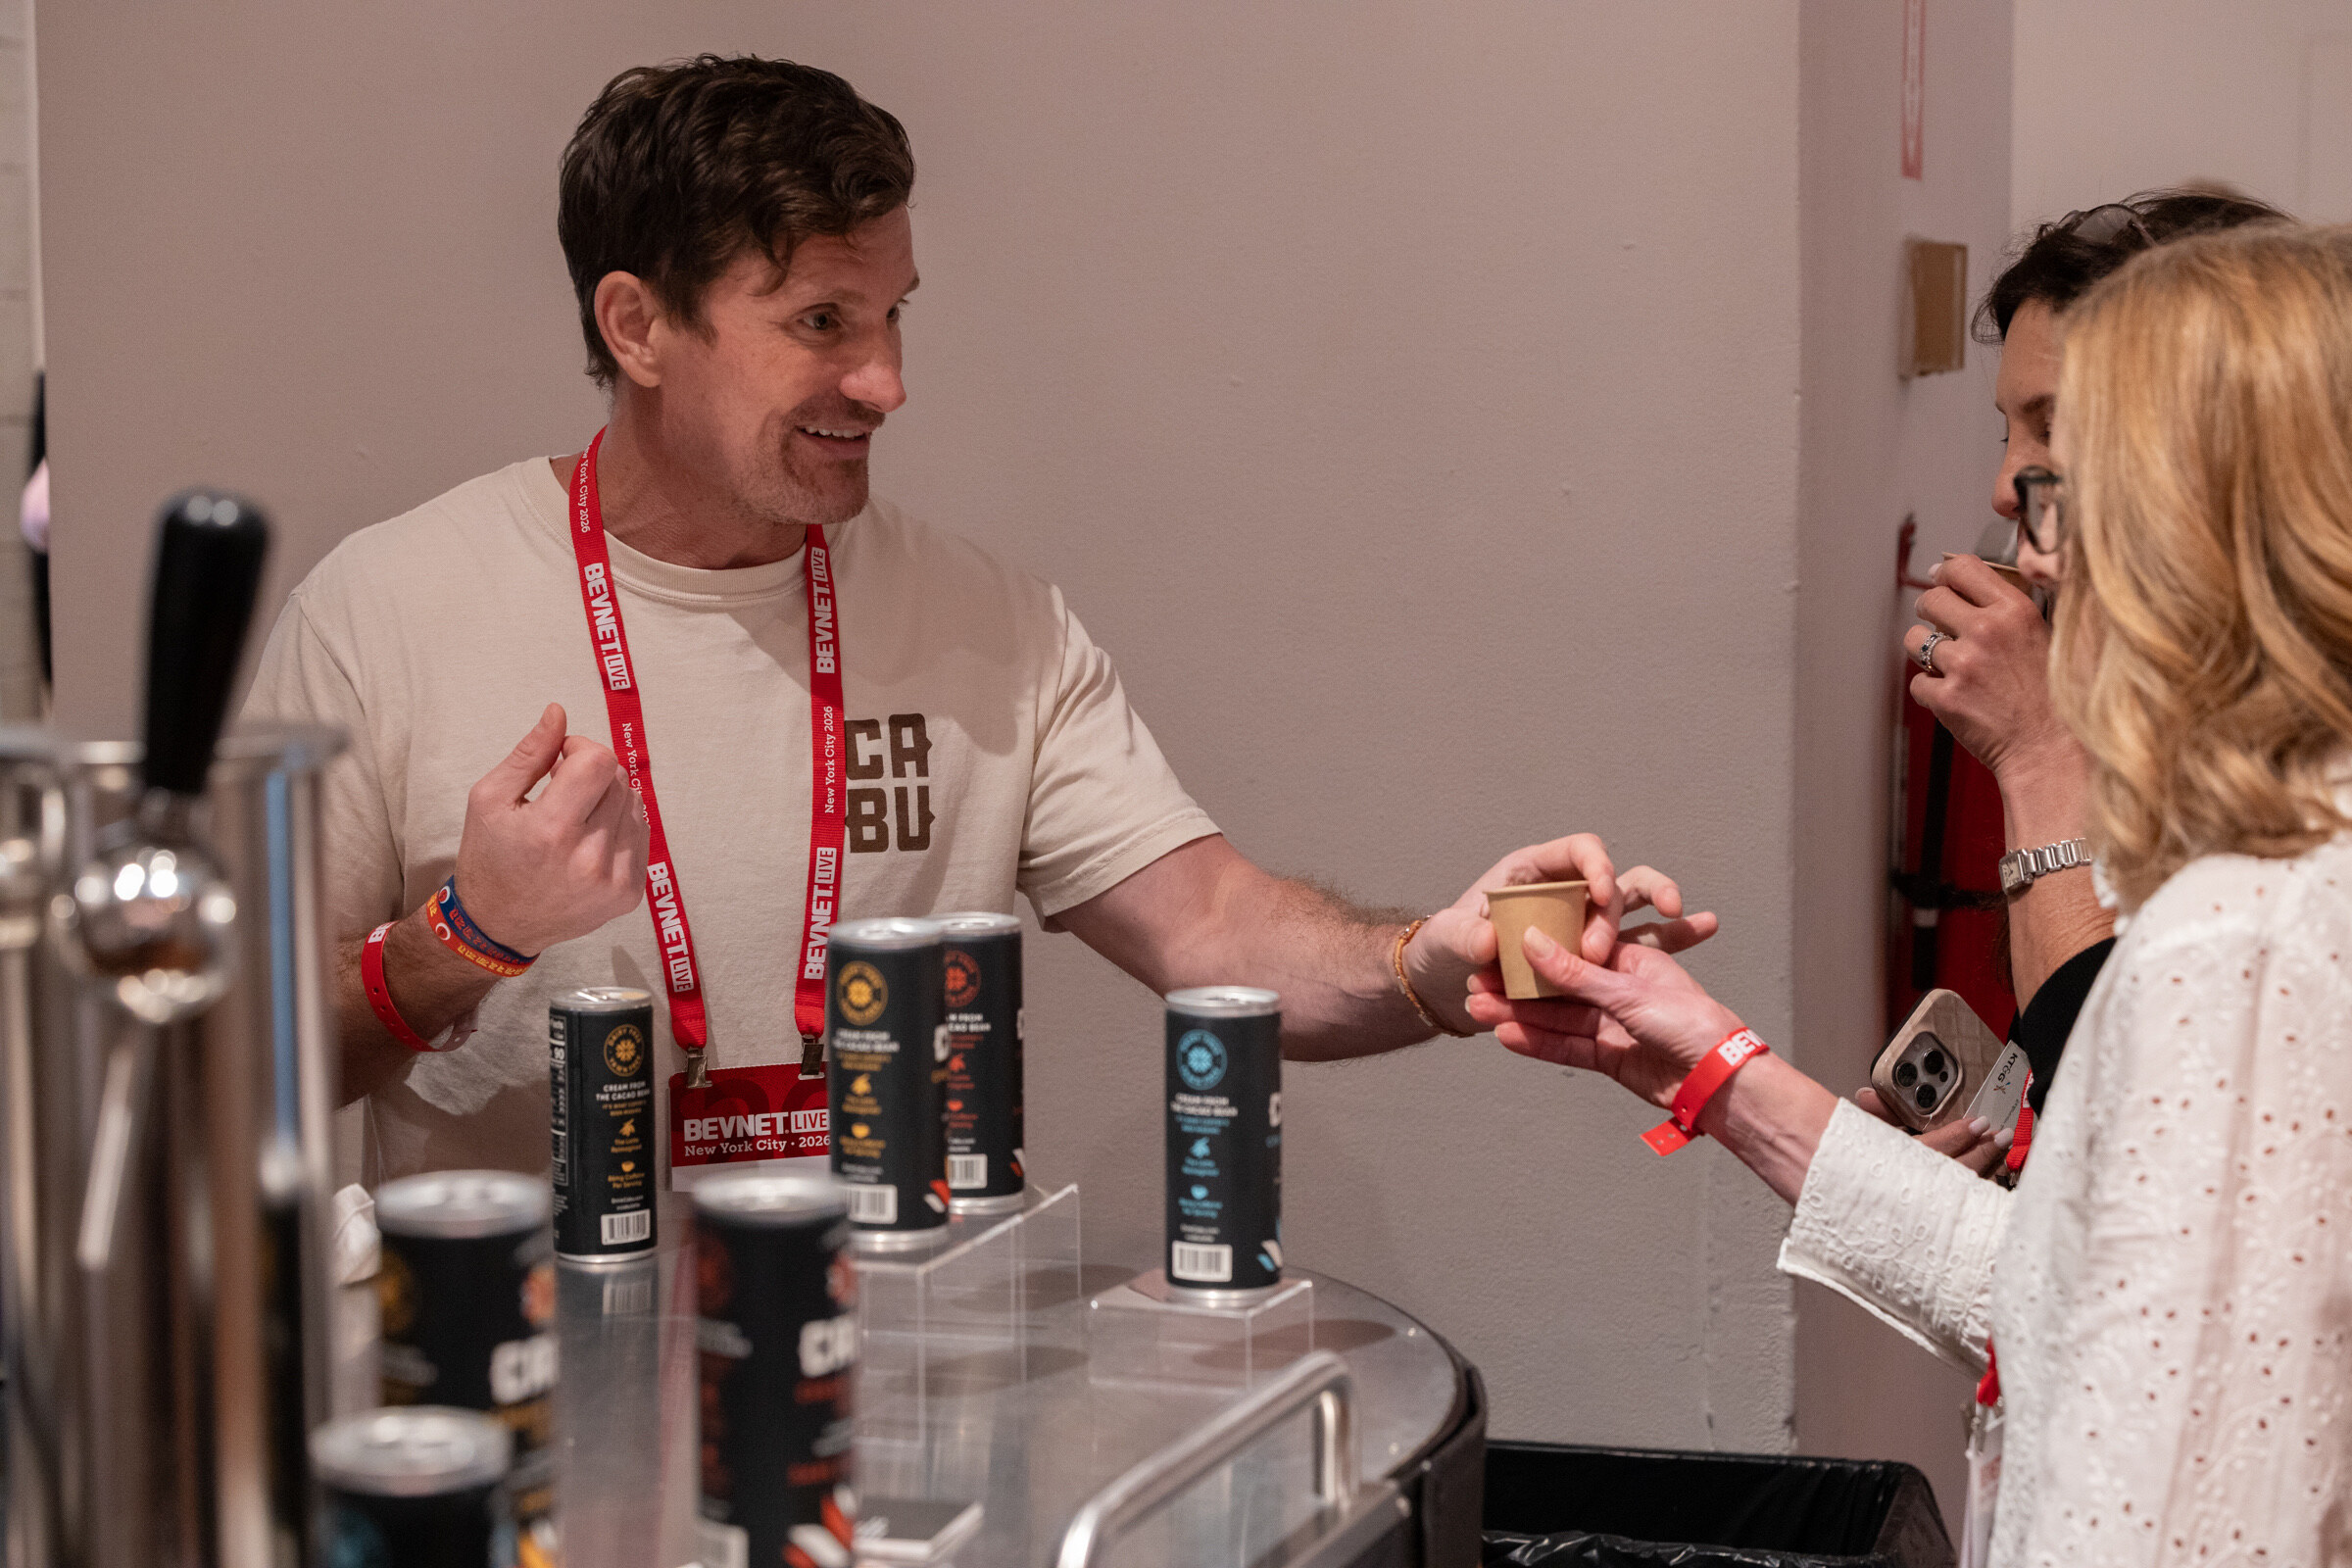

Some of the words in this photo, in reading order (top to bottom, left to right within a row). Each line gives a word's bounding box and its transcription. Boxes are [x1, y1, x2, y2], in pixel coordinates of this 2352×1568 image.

[577, 485, 589, 507] City
[579, 508, 591, 533] 2026
[812, 548, 828, 580] LIVE
[606, 655, 629, 689] LIVE
[823, 706, 833, 732] 2026
[621, 722, 633, 748] New
[627, 750, 639, 776] York
[824, 733, 836, 758] City
[825, 759, 835, 785] York
[825, 787, 834, 813] New
[815, 849, 835, 882] LIVE
[671, 958, 693, 992] LIVE
[1997, 1053, 2019, 1083] KT&G
[596, 1093, 610, 1102] THE
[603, 1083, 628, 1093] CREAM
[792, 1110, 830, 1132] LIVE
[684, 1145, 716, 1156] New
[719, 1141, 754, 1153] York
[756, 1138, 787, 1152] City
[799, 1135, 831, 1149] 2026
